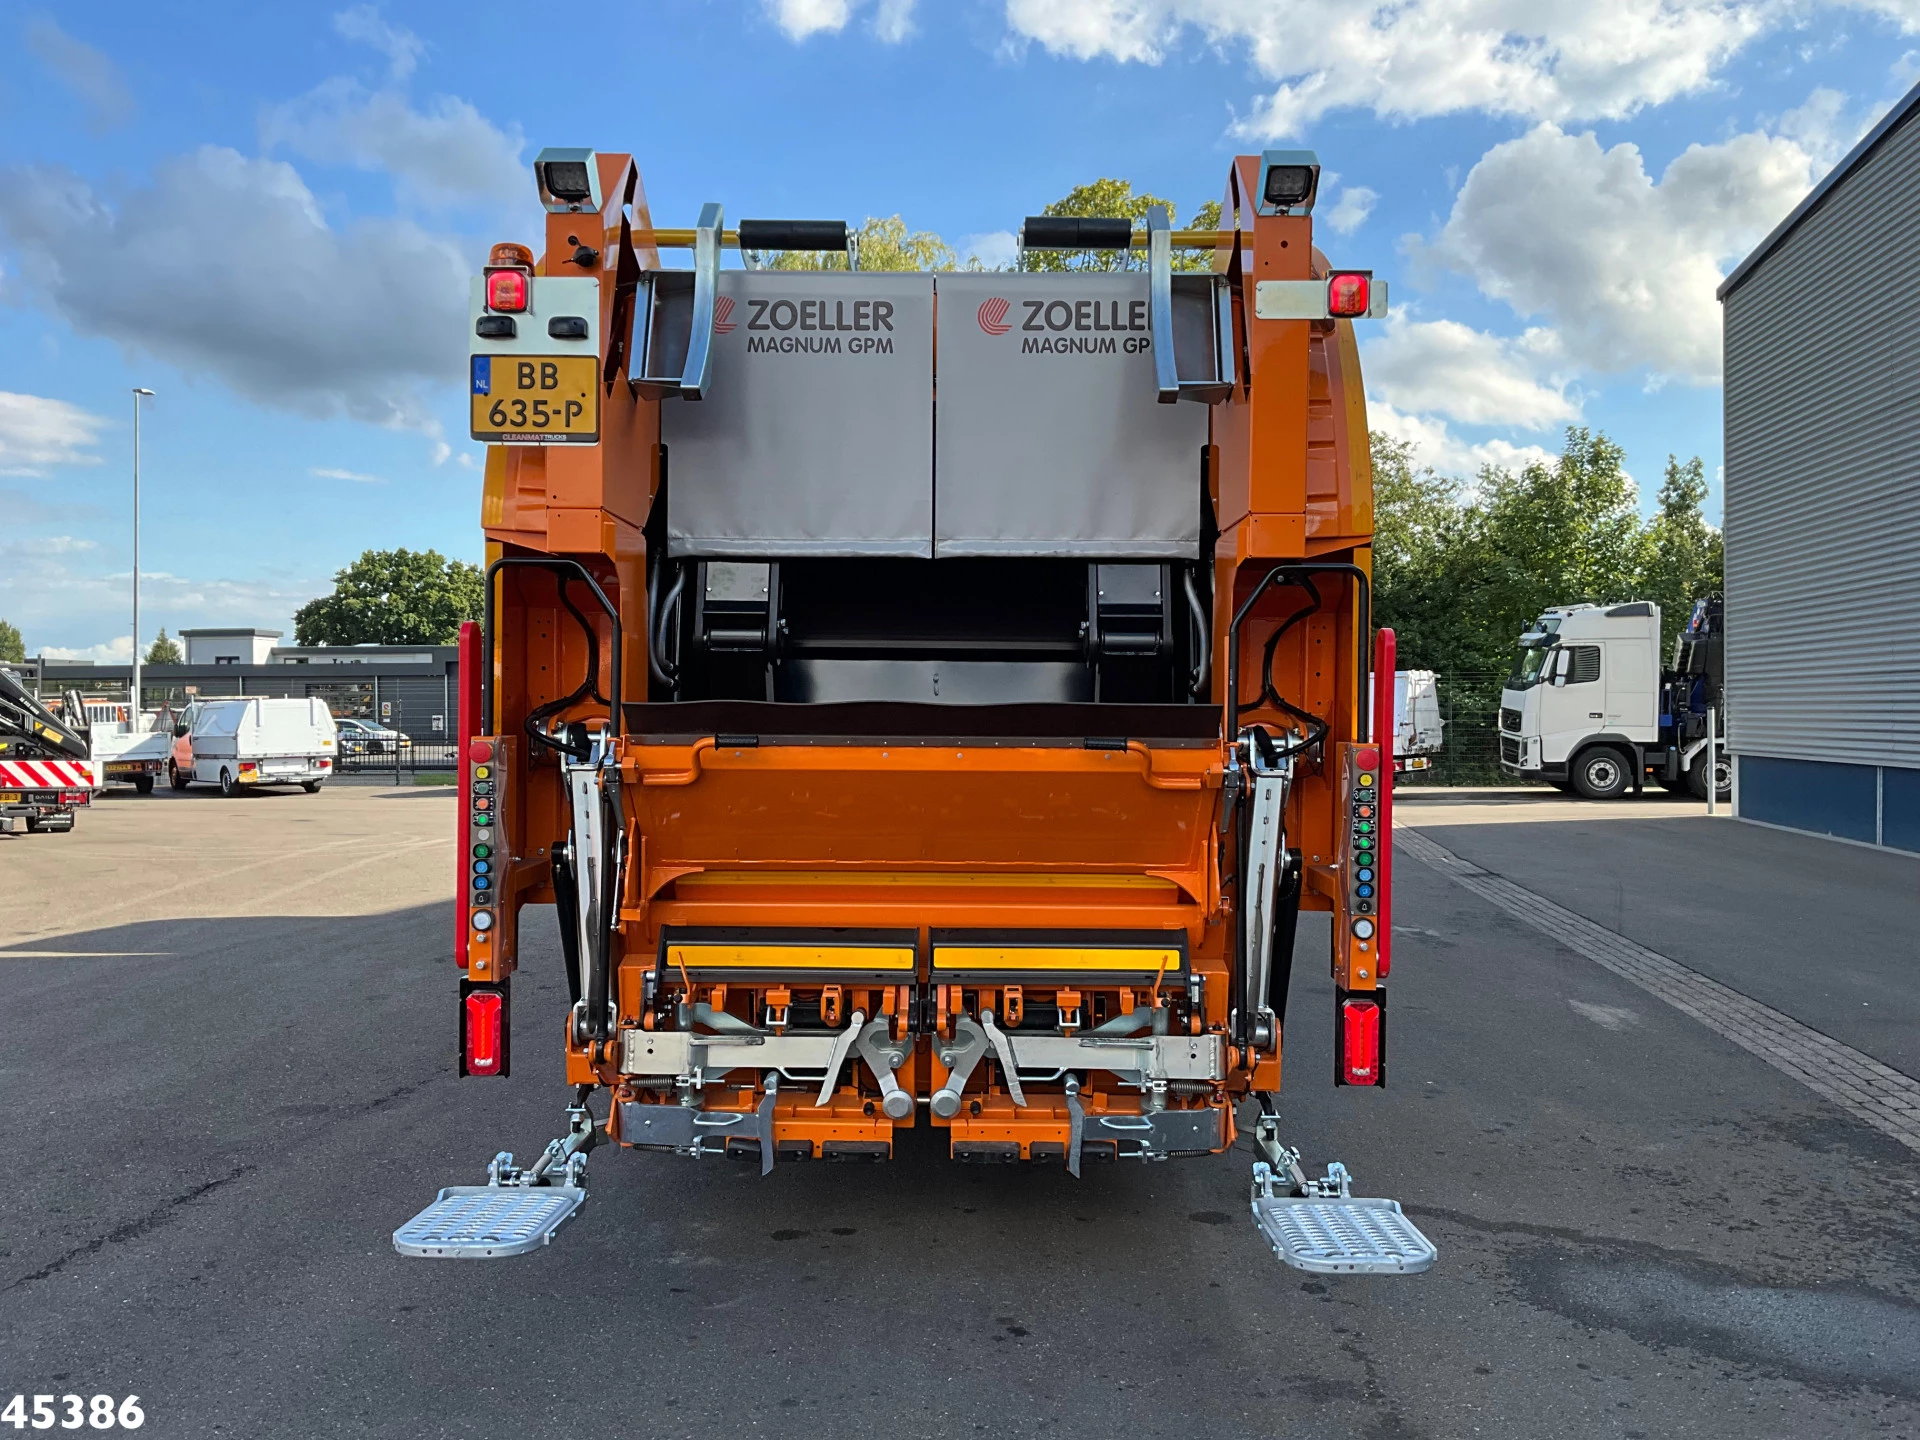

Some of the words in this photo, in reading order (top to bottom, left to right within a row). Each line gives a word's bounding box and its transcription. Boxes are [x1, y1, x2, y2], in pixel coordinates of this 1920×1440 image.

[747, 299, 894, 331] ZOELLER
[1021, 300, 1152, 332] ZOELLE
[747, 336, 842, 354] MAGNUM
[848, 337, 894, 354] GPM
[1021, 337, 1117, 354] MAGNUM
[1122, 337, 1152, 354] GP
[475, 380, 489, 389] NL
[517, 362, 559, 390] BB
[488, 398, 583, 428] 635-P
